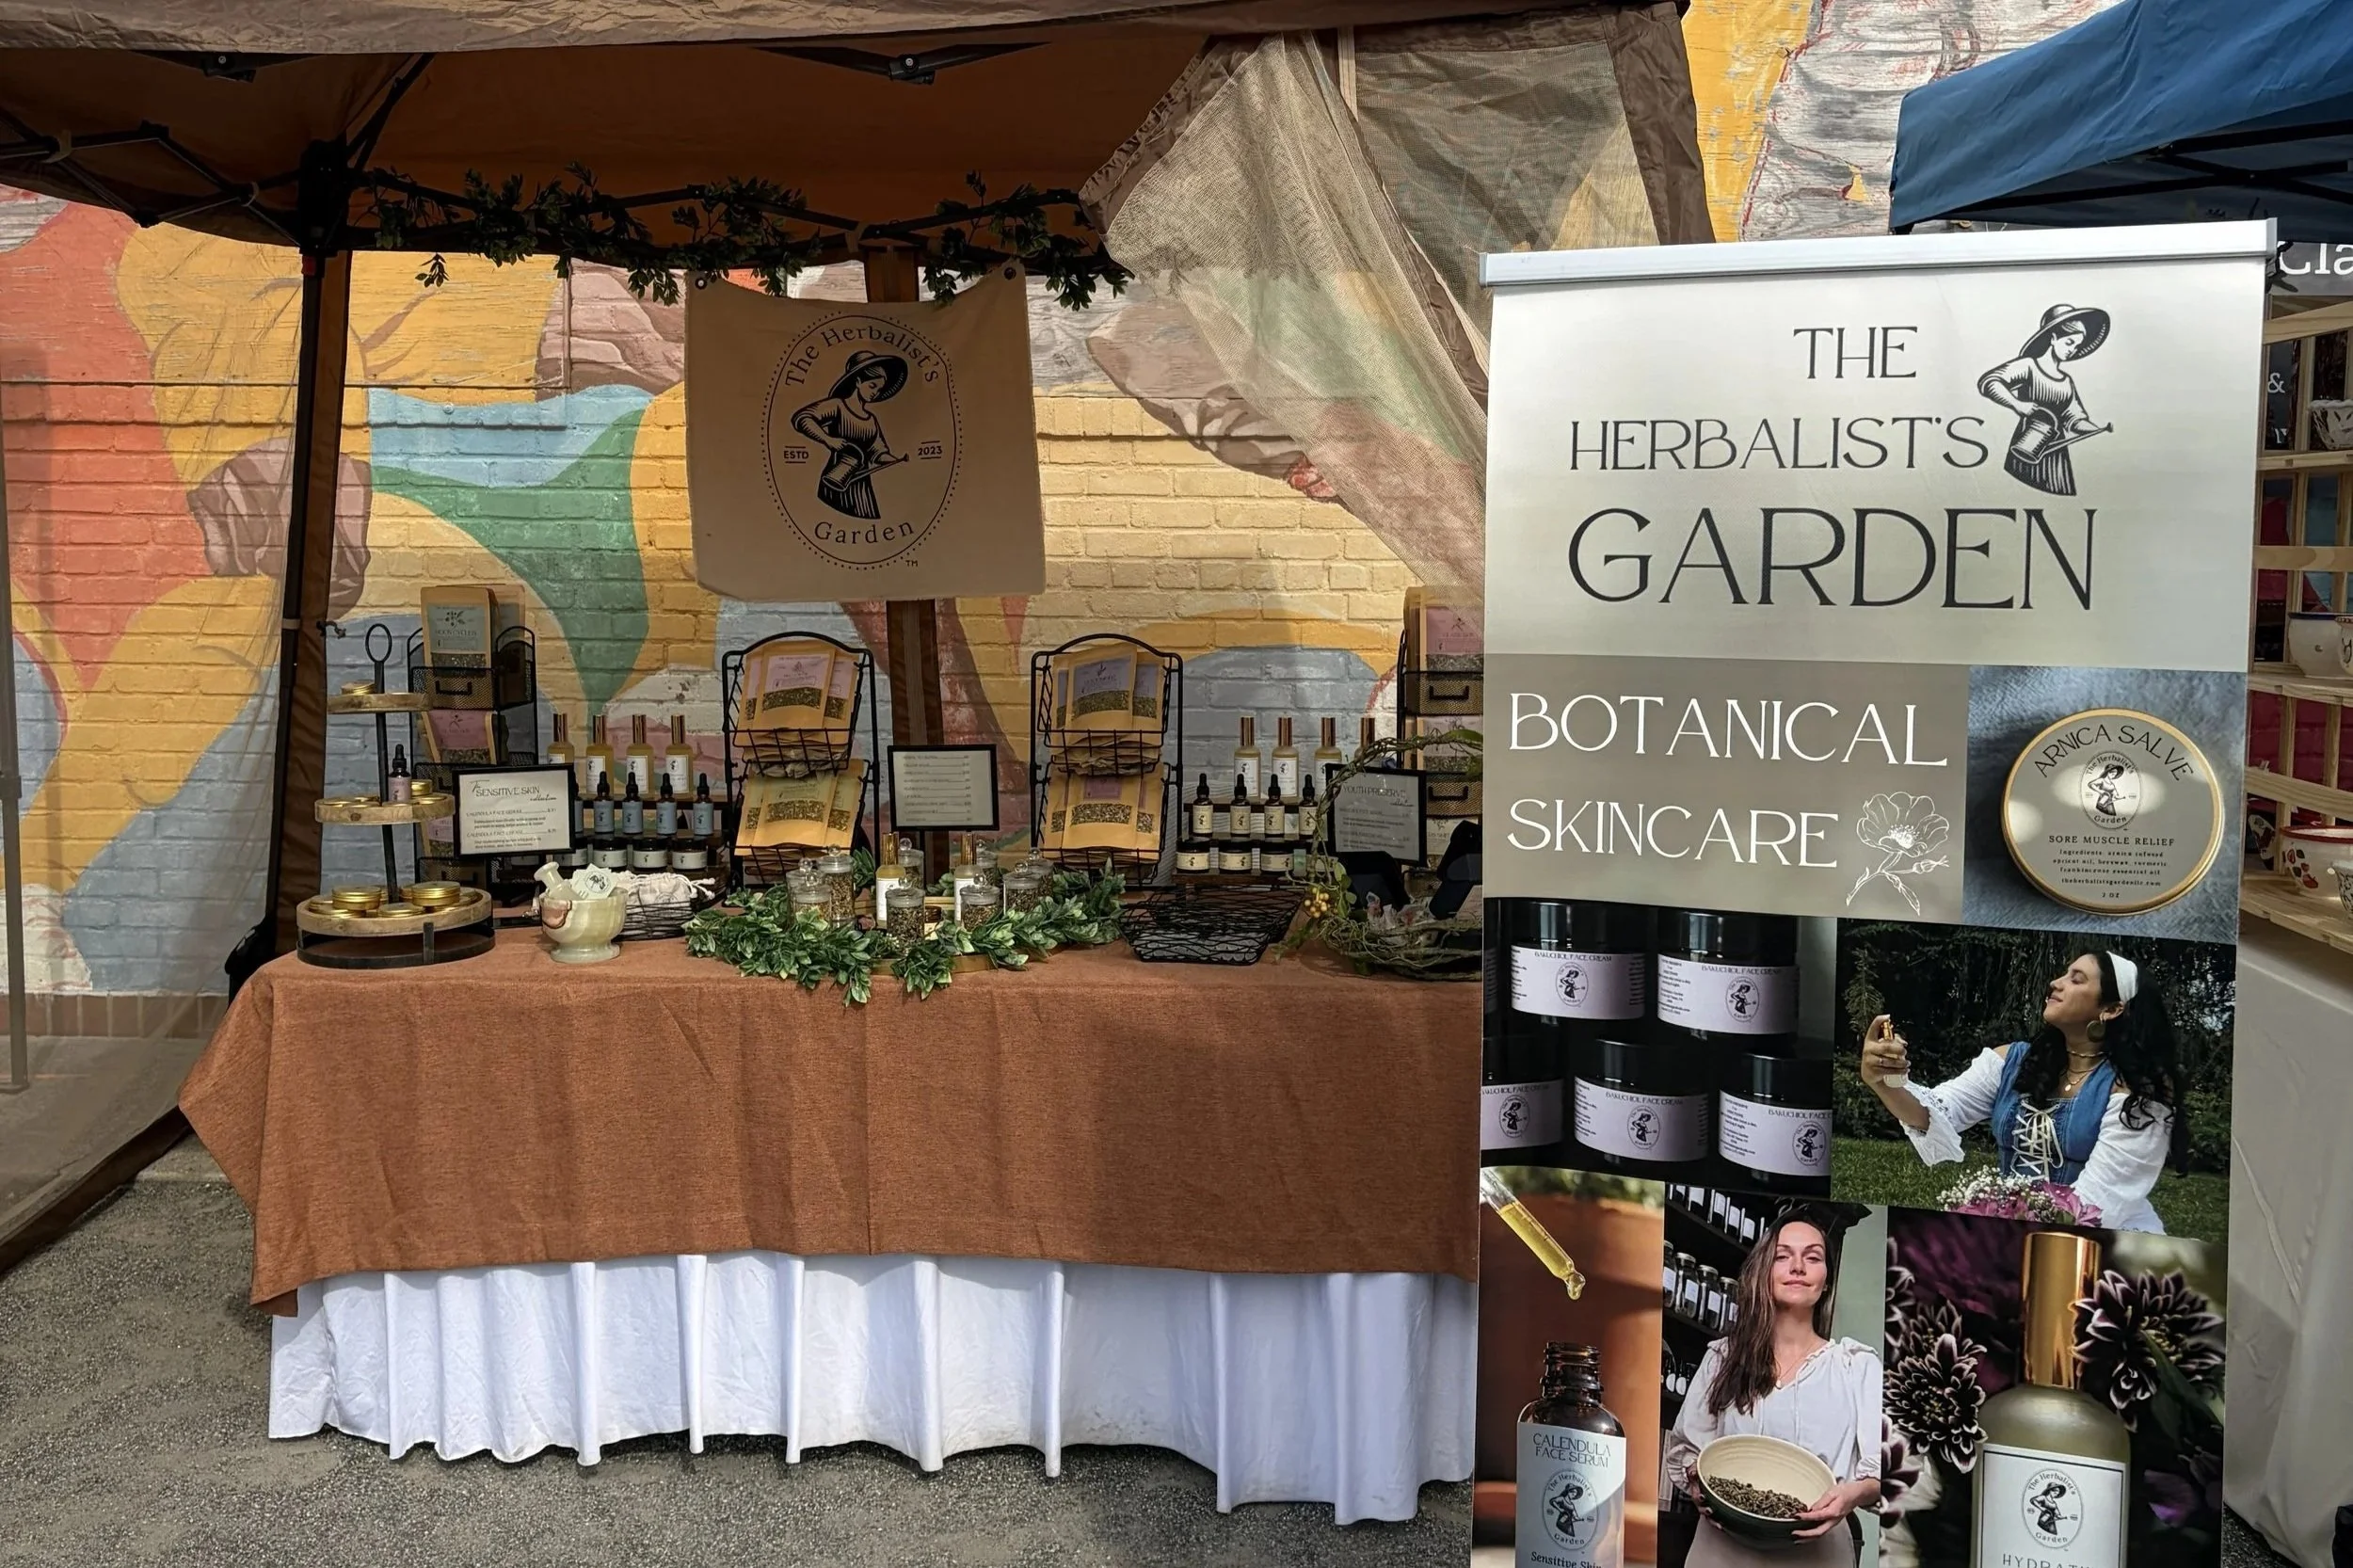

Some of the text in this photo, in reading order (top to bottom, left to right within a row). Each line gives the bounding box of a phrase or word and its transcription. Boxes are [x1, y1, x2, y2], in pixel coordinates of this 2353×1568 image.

[785, 325, 939, 388] The Herbalist's
[1793, 326, 1918, 379] THE
[783, 449, 809, 460] ESTD
[917, 445, 943, 456] 2023
[1570, 415, 1990, 472] HERBALIST'S
[813, 520, 915, 545] Garden
[1568, 506, 2098, 611] GARDEN
[1509, 692, 1948, 767] BOTANICAL
[2034, 724, 2194, 781] ARNICA SALVE
[475, 785, 540, 797] SENSITIVE SKIN
[2093, 814, 2127, 824] Garden
[1506, 798, 1839, 869] SKINCARE
[2049, 835, 2175, 846] SORE MUSCLE RELIEF
[1532, 1432, 1611, 1457] CALENDULA
[1535, 1446, 1609, 1468] FACE SERUM
[2035, 1531, 2068, 1544] Garden
[1530, 1551, 1577, 1568] Sensitive
